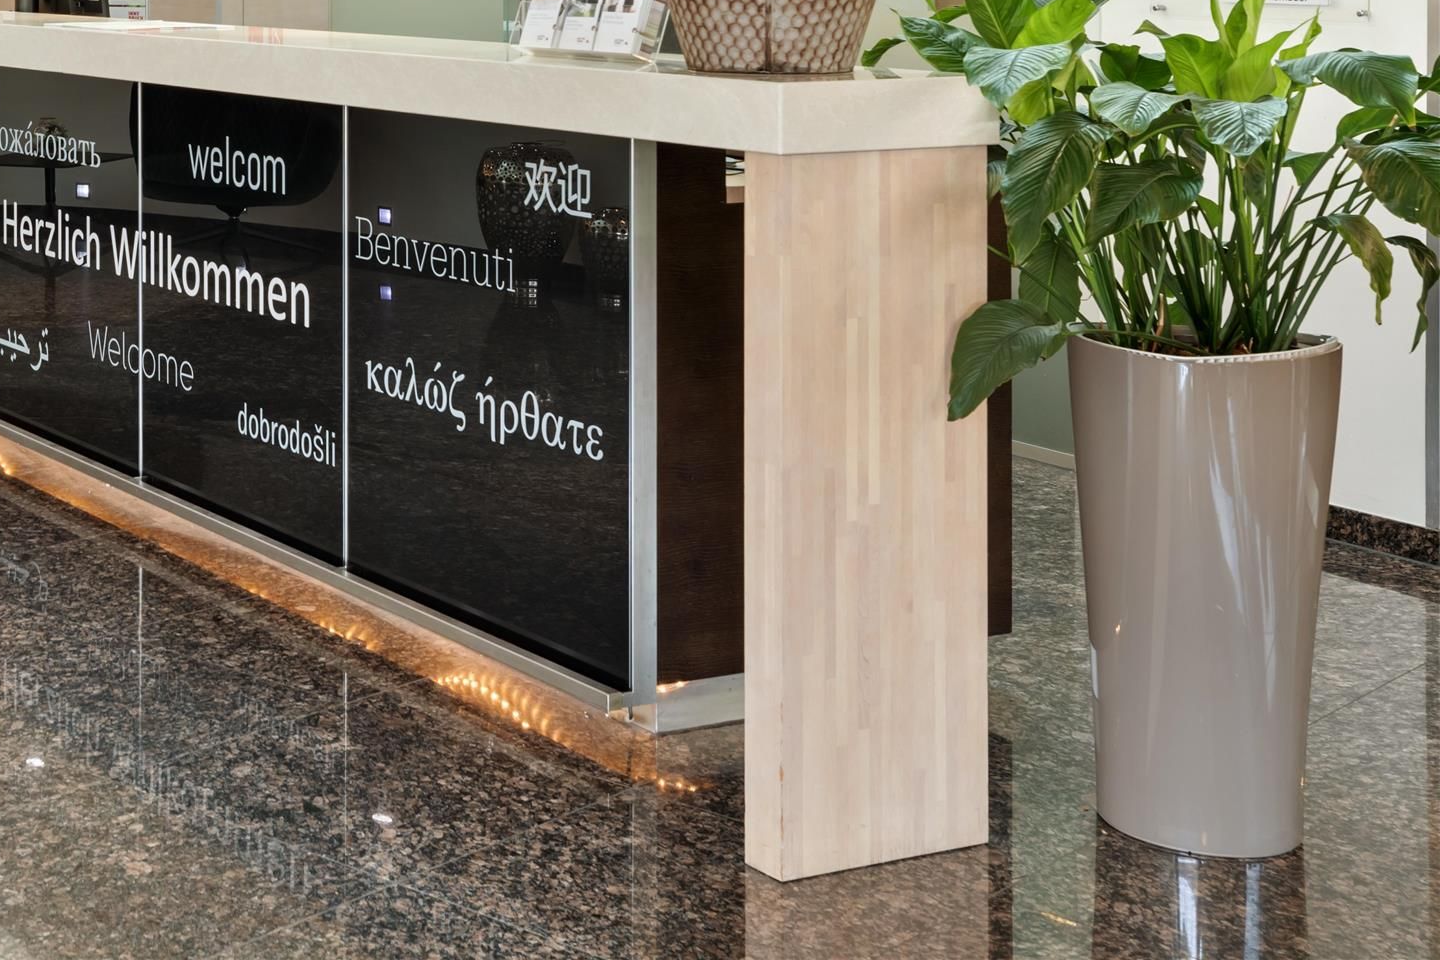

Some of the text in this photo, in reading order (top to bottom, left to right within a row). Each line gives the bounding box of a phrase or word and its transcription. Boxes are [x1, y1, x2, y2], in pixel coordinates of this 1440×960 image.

[188, 135, 286, 195] welcom
[523, 158, 593, 219] 欢迎
[2, 199, 311, 329] Herzlich Willkommen
[354, 215, 516, 293] Benvenuti
[87, 320, 195, 392] Welcome
[237, 402, 337, 468] dobrodošli
[475, 375, 604, 461] ήρθατε
